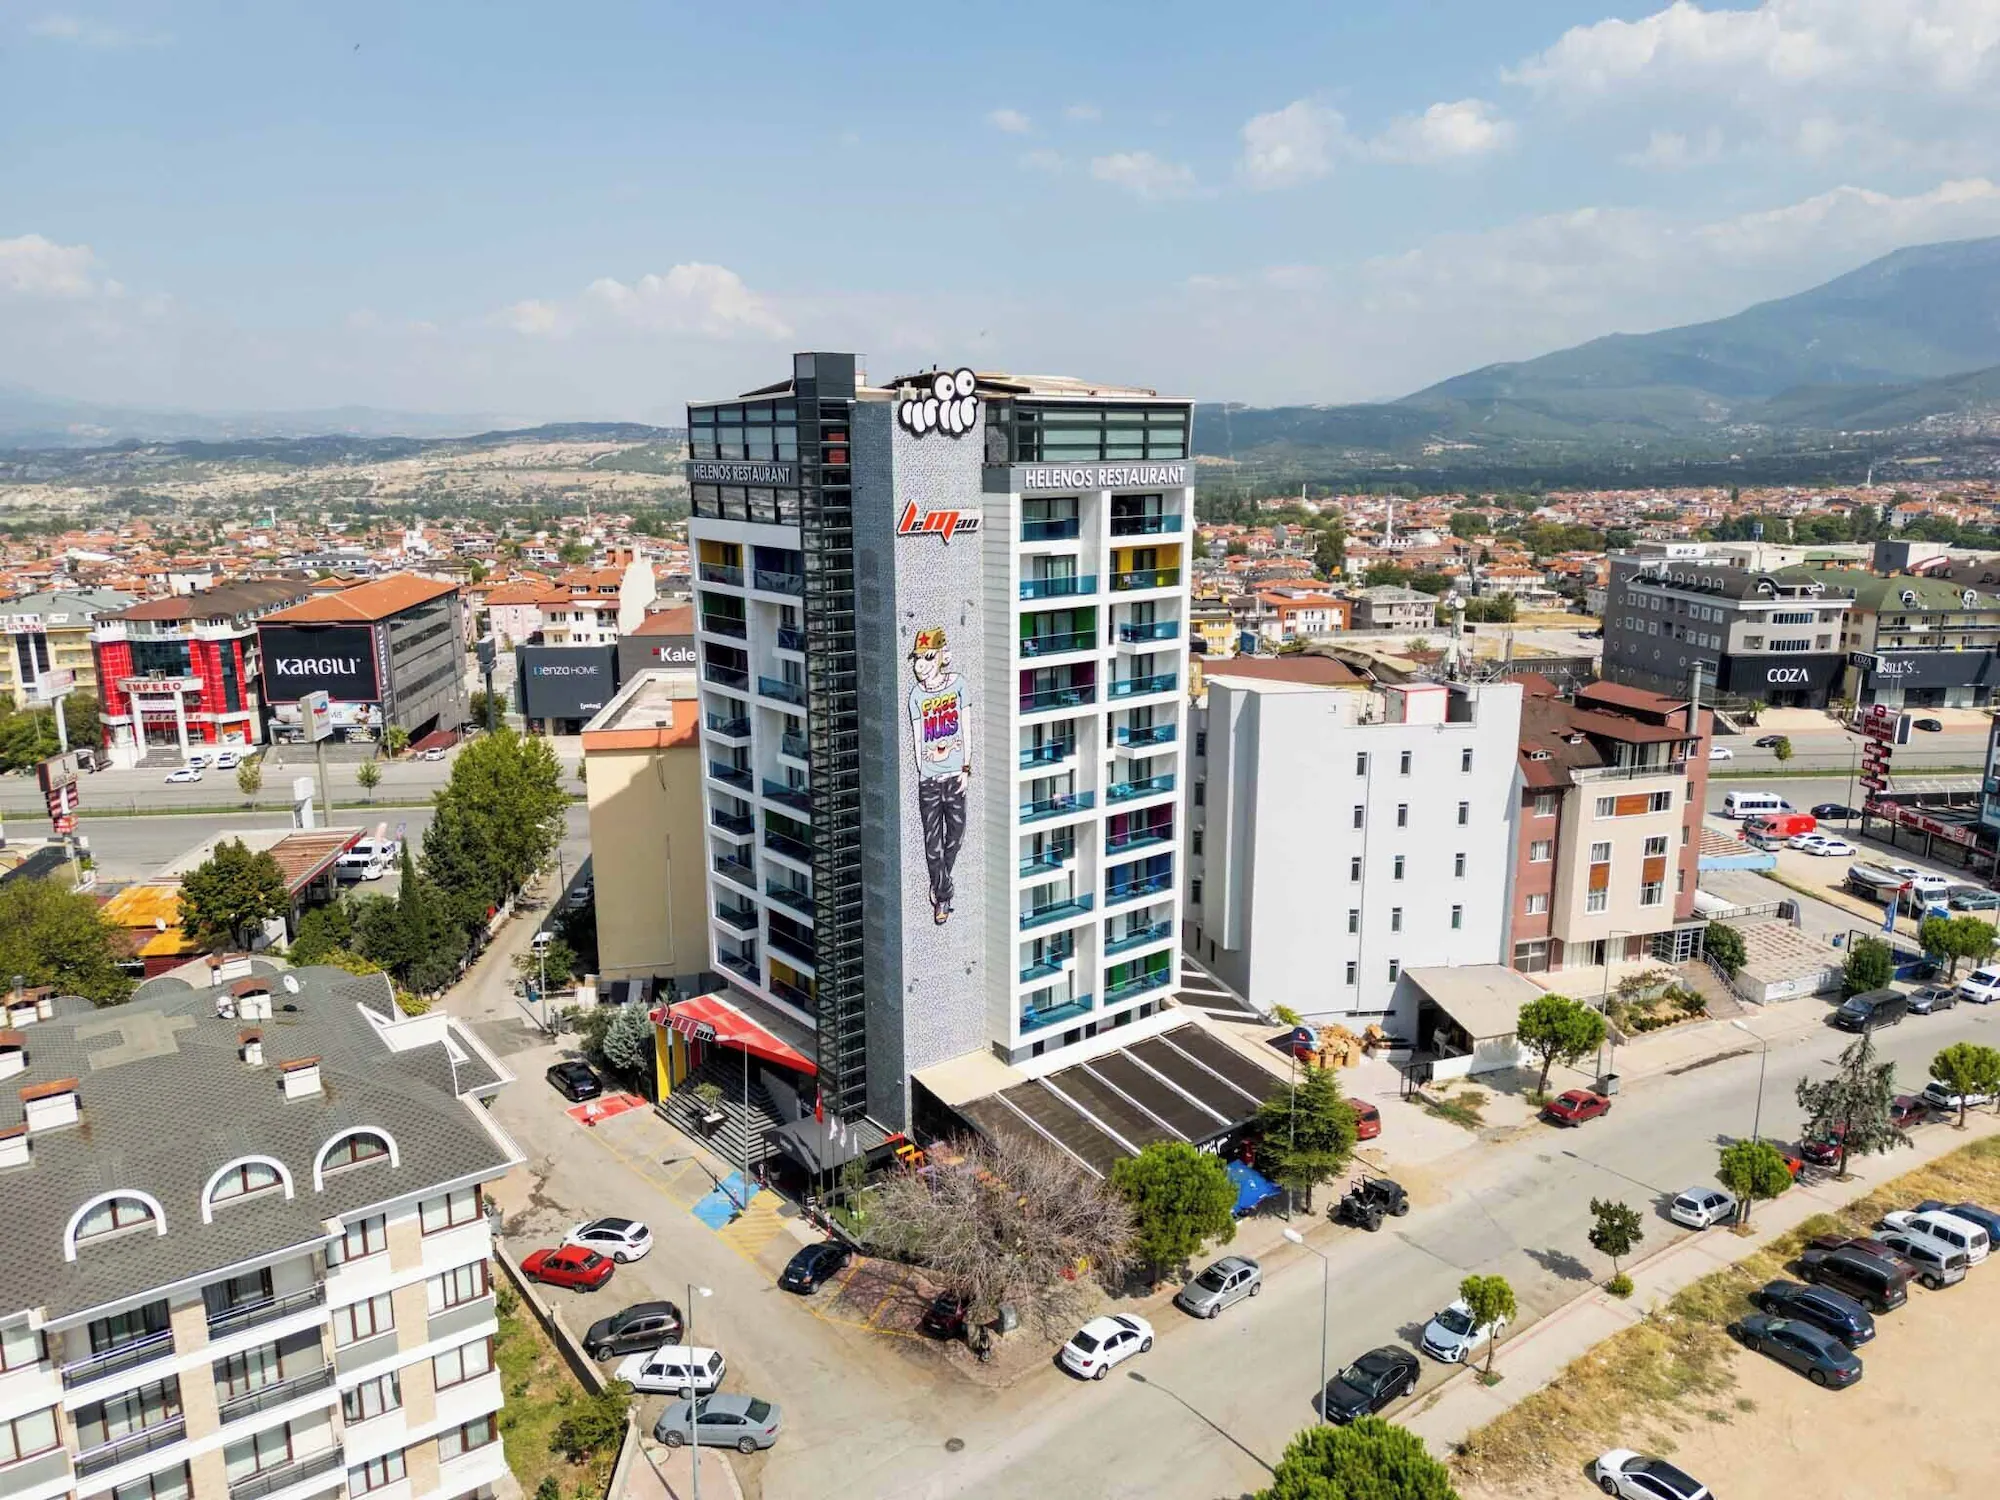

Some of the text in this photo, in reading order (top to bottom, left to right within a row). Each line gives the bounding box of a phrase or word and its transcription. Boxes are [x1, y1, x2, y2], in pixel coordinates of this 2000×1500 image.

[693, 464, 790, 483] HELENOS RESTAURANT
[1025, 466, 1186, 488] HELENOS RESTAURANT
[660, 647, 696, 662] Kale
[1853, 654, 1872, 666] COZA
[571, 666, 599, 675] HOME
[1767, 668, 1809, 683] COZA
[125, 682, 182, 691] EMPERO
[922, 692, 957, 717] FREE
[924, 710, 959, 742] HUGS
